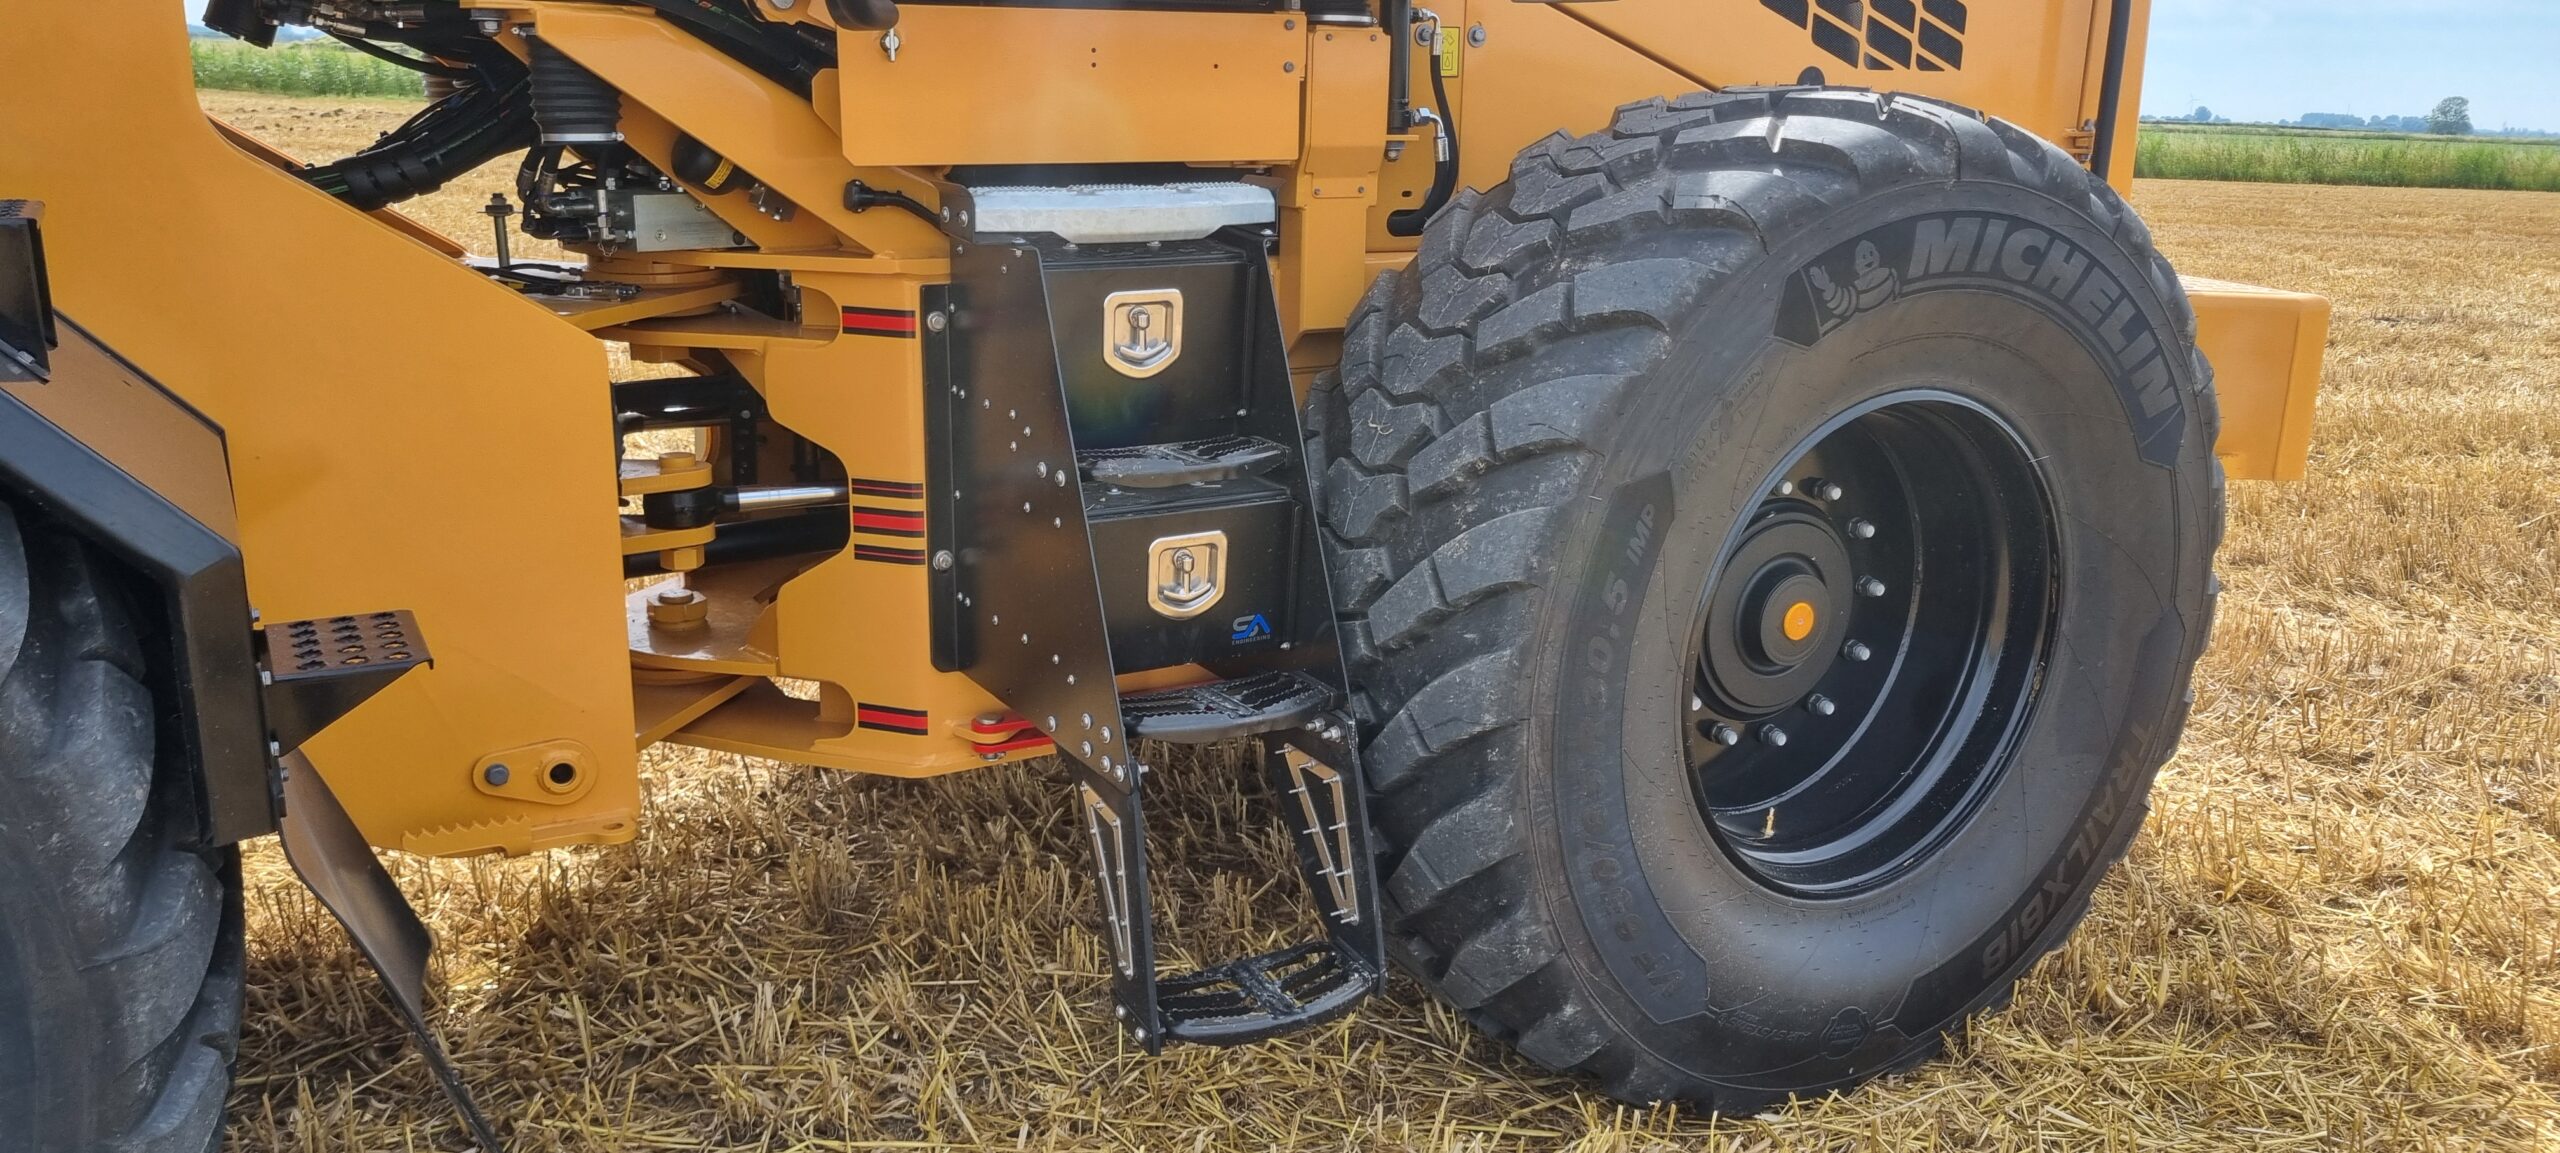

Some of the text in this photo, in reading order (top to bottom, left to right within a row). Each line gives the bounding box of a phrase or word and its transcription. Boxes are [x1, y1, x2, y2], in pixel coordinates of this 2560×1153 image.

[1906, 216, 2178, 418] MICHELIN
[1625, 503, 1658, 569] IMP
[1232, 614, 1270, 637] SA
[1982, 722, 2152, 976] TRAILXBIB
